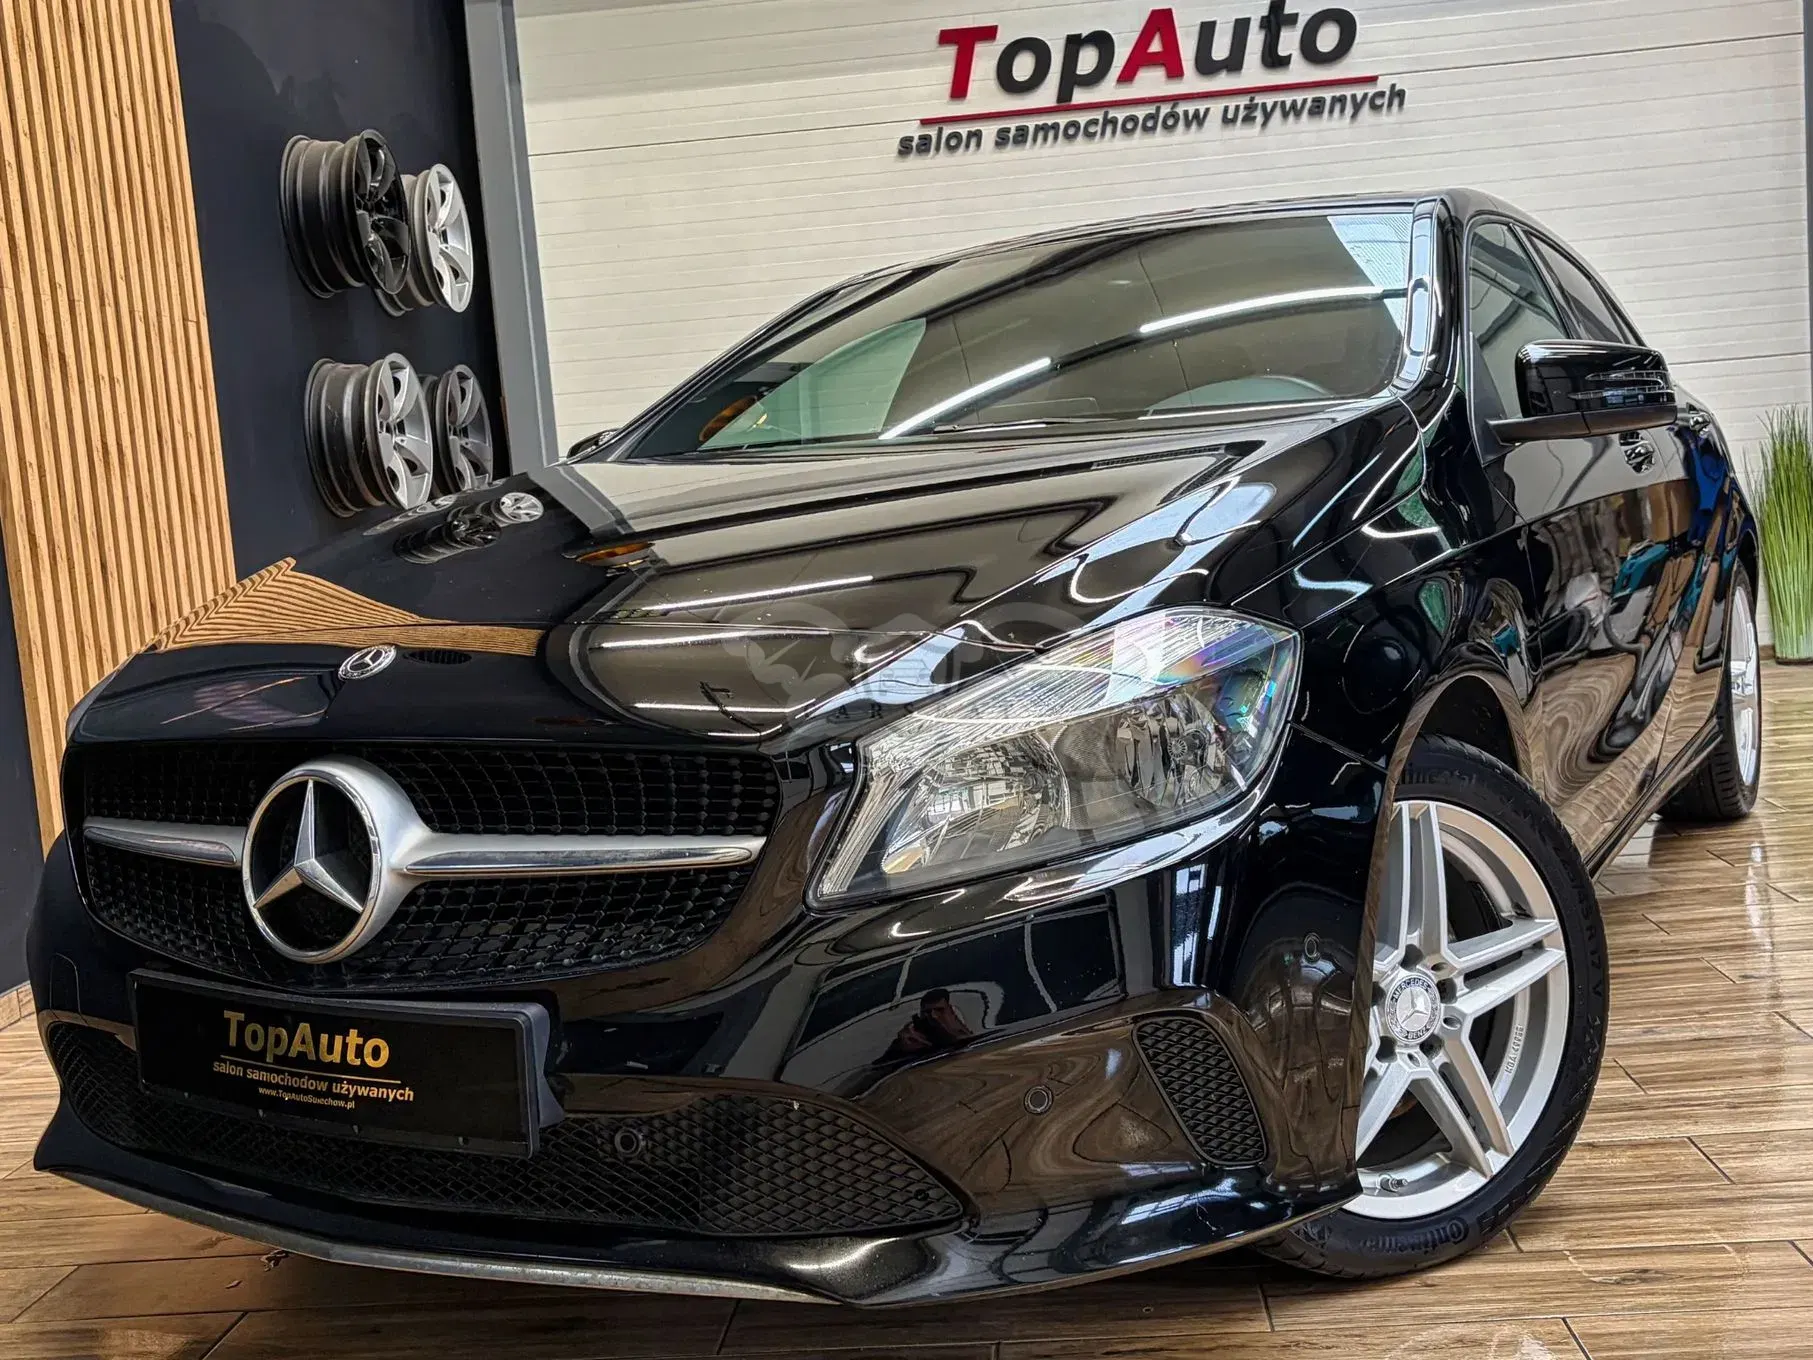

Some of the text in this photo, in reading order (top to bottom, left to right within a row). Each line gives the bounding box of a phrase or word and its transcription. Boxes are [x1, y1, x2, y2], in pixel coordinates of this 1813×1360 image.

[937, 0, 1358, 103] TopAuto
[897, 82, 1407, 157] salon samochodów używanych
[1392, 977, 1430, 1000] MERCEDES
[223, 1009, 391, 1069] TopAuto
[212, 1059, 244, 1078] salon
[332, 1080, 415, 1103] używanych
